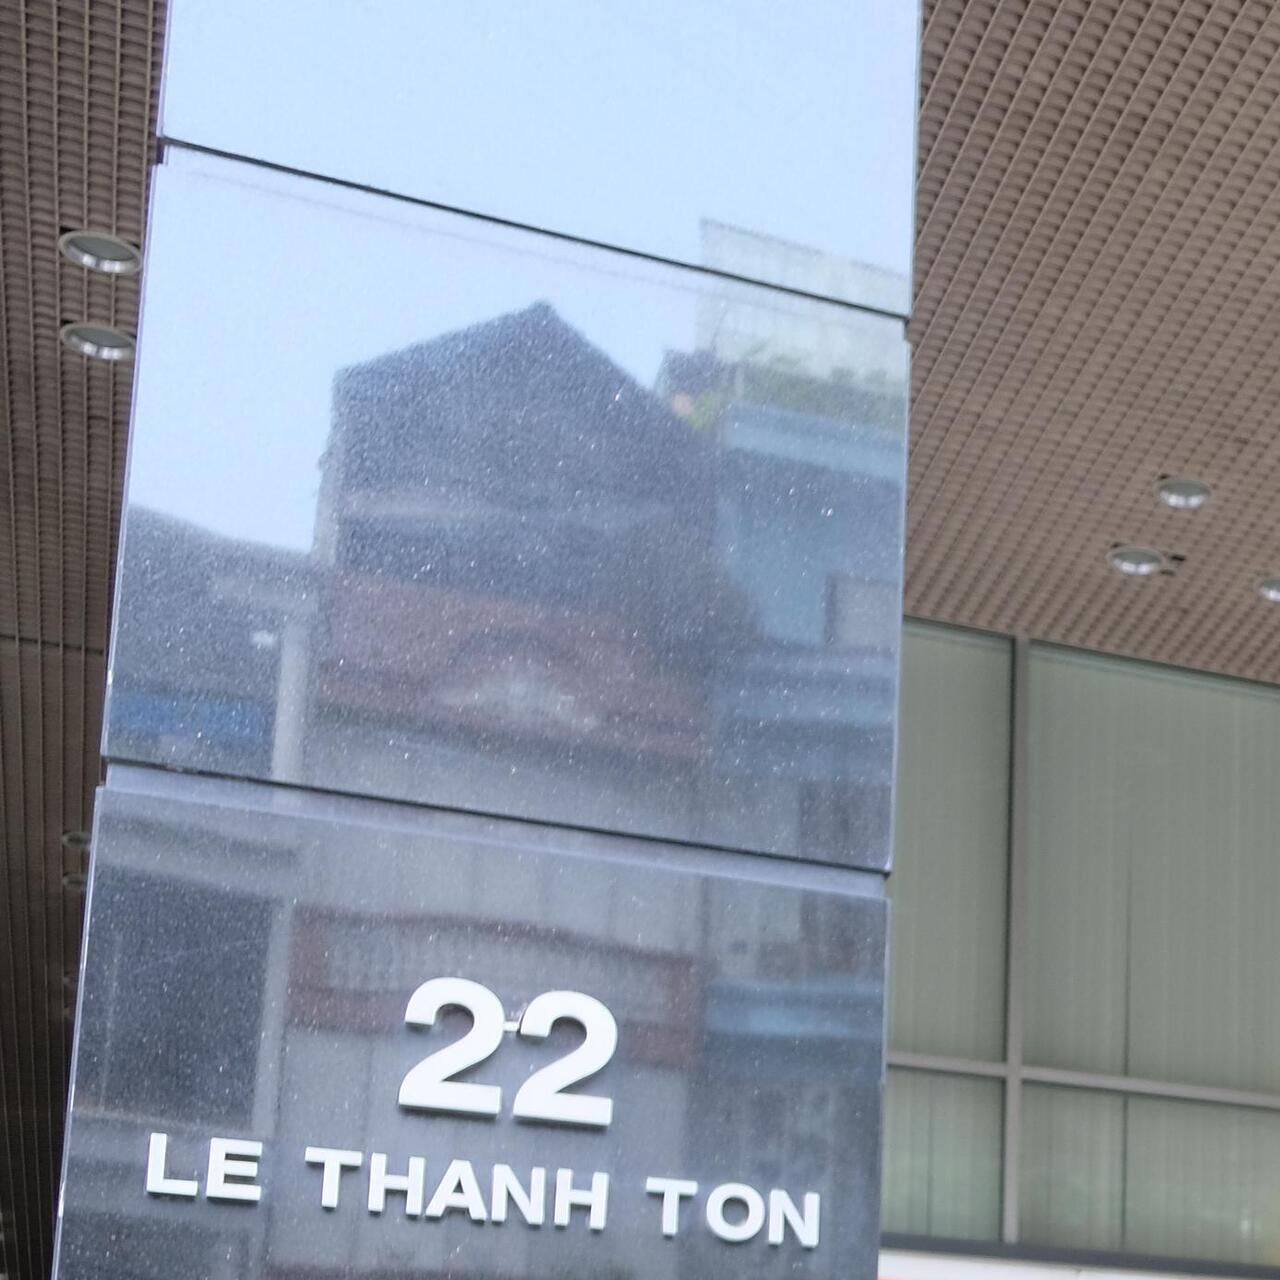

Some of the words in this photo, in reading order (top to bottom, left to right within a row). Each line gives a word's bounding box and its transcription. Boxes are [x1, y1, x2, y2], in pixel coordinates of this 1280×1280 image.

[398, 976, 618, 1126] 22
[145, 1132, 263, 1202] LE
[304, 1146, 610, 1231] THANH
[645, 1176, 822, 1248] TON
